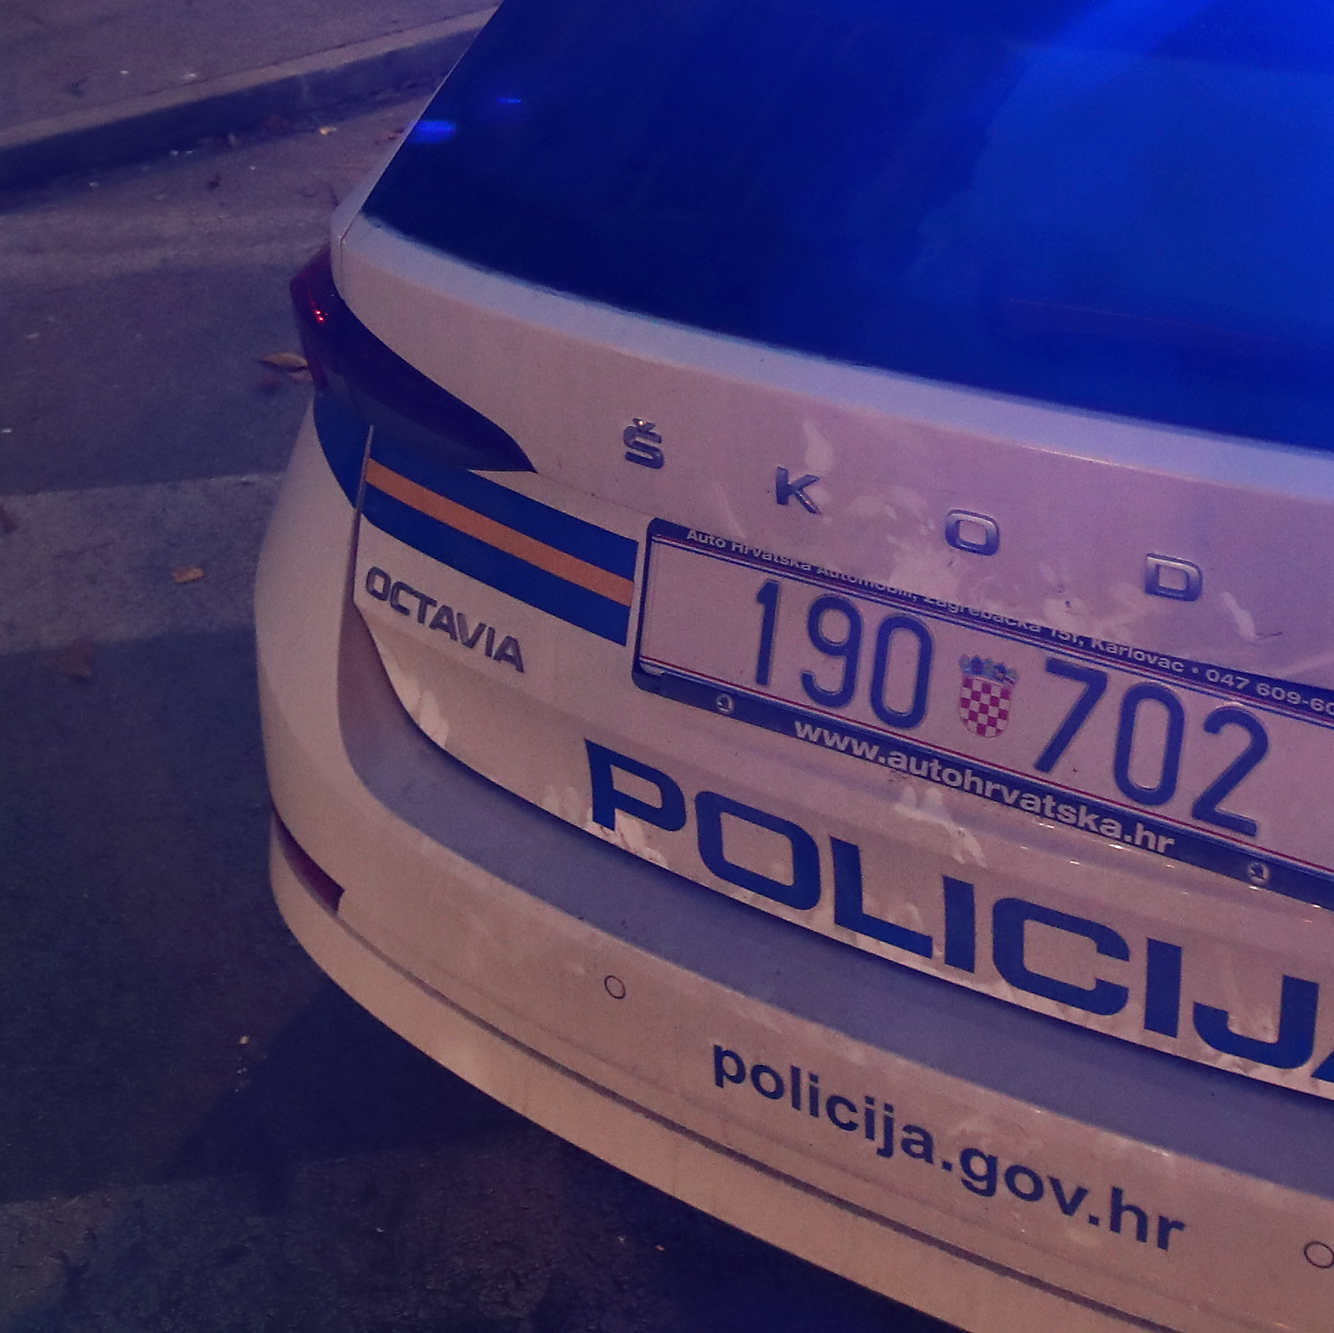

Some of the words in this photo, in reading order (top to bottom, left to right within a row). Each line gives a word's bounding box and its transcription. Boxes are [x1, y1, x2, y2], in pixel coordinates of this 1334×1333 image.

[366, 566, 525, 674] OCTAVIA
[687, 528, 727, 549] Auto
[731, 542, 812, 572] Hrvatska
[1091, 637, 1185, 673] Karlovac
[1205, 668, 1250, 690] 047
[755, 578, 934, 730] 190
[1033, 657, 1270, 839] 702
[793, 719, 1176, 855] www.autohrvatska.hr
[713, 1043, 1186, 1252] policija.gov.hr
